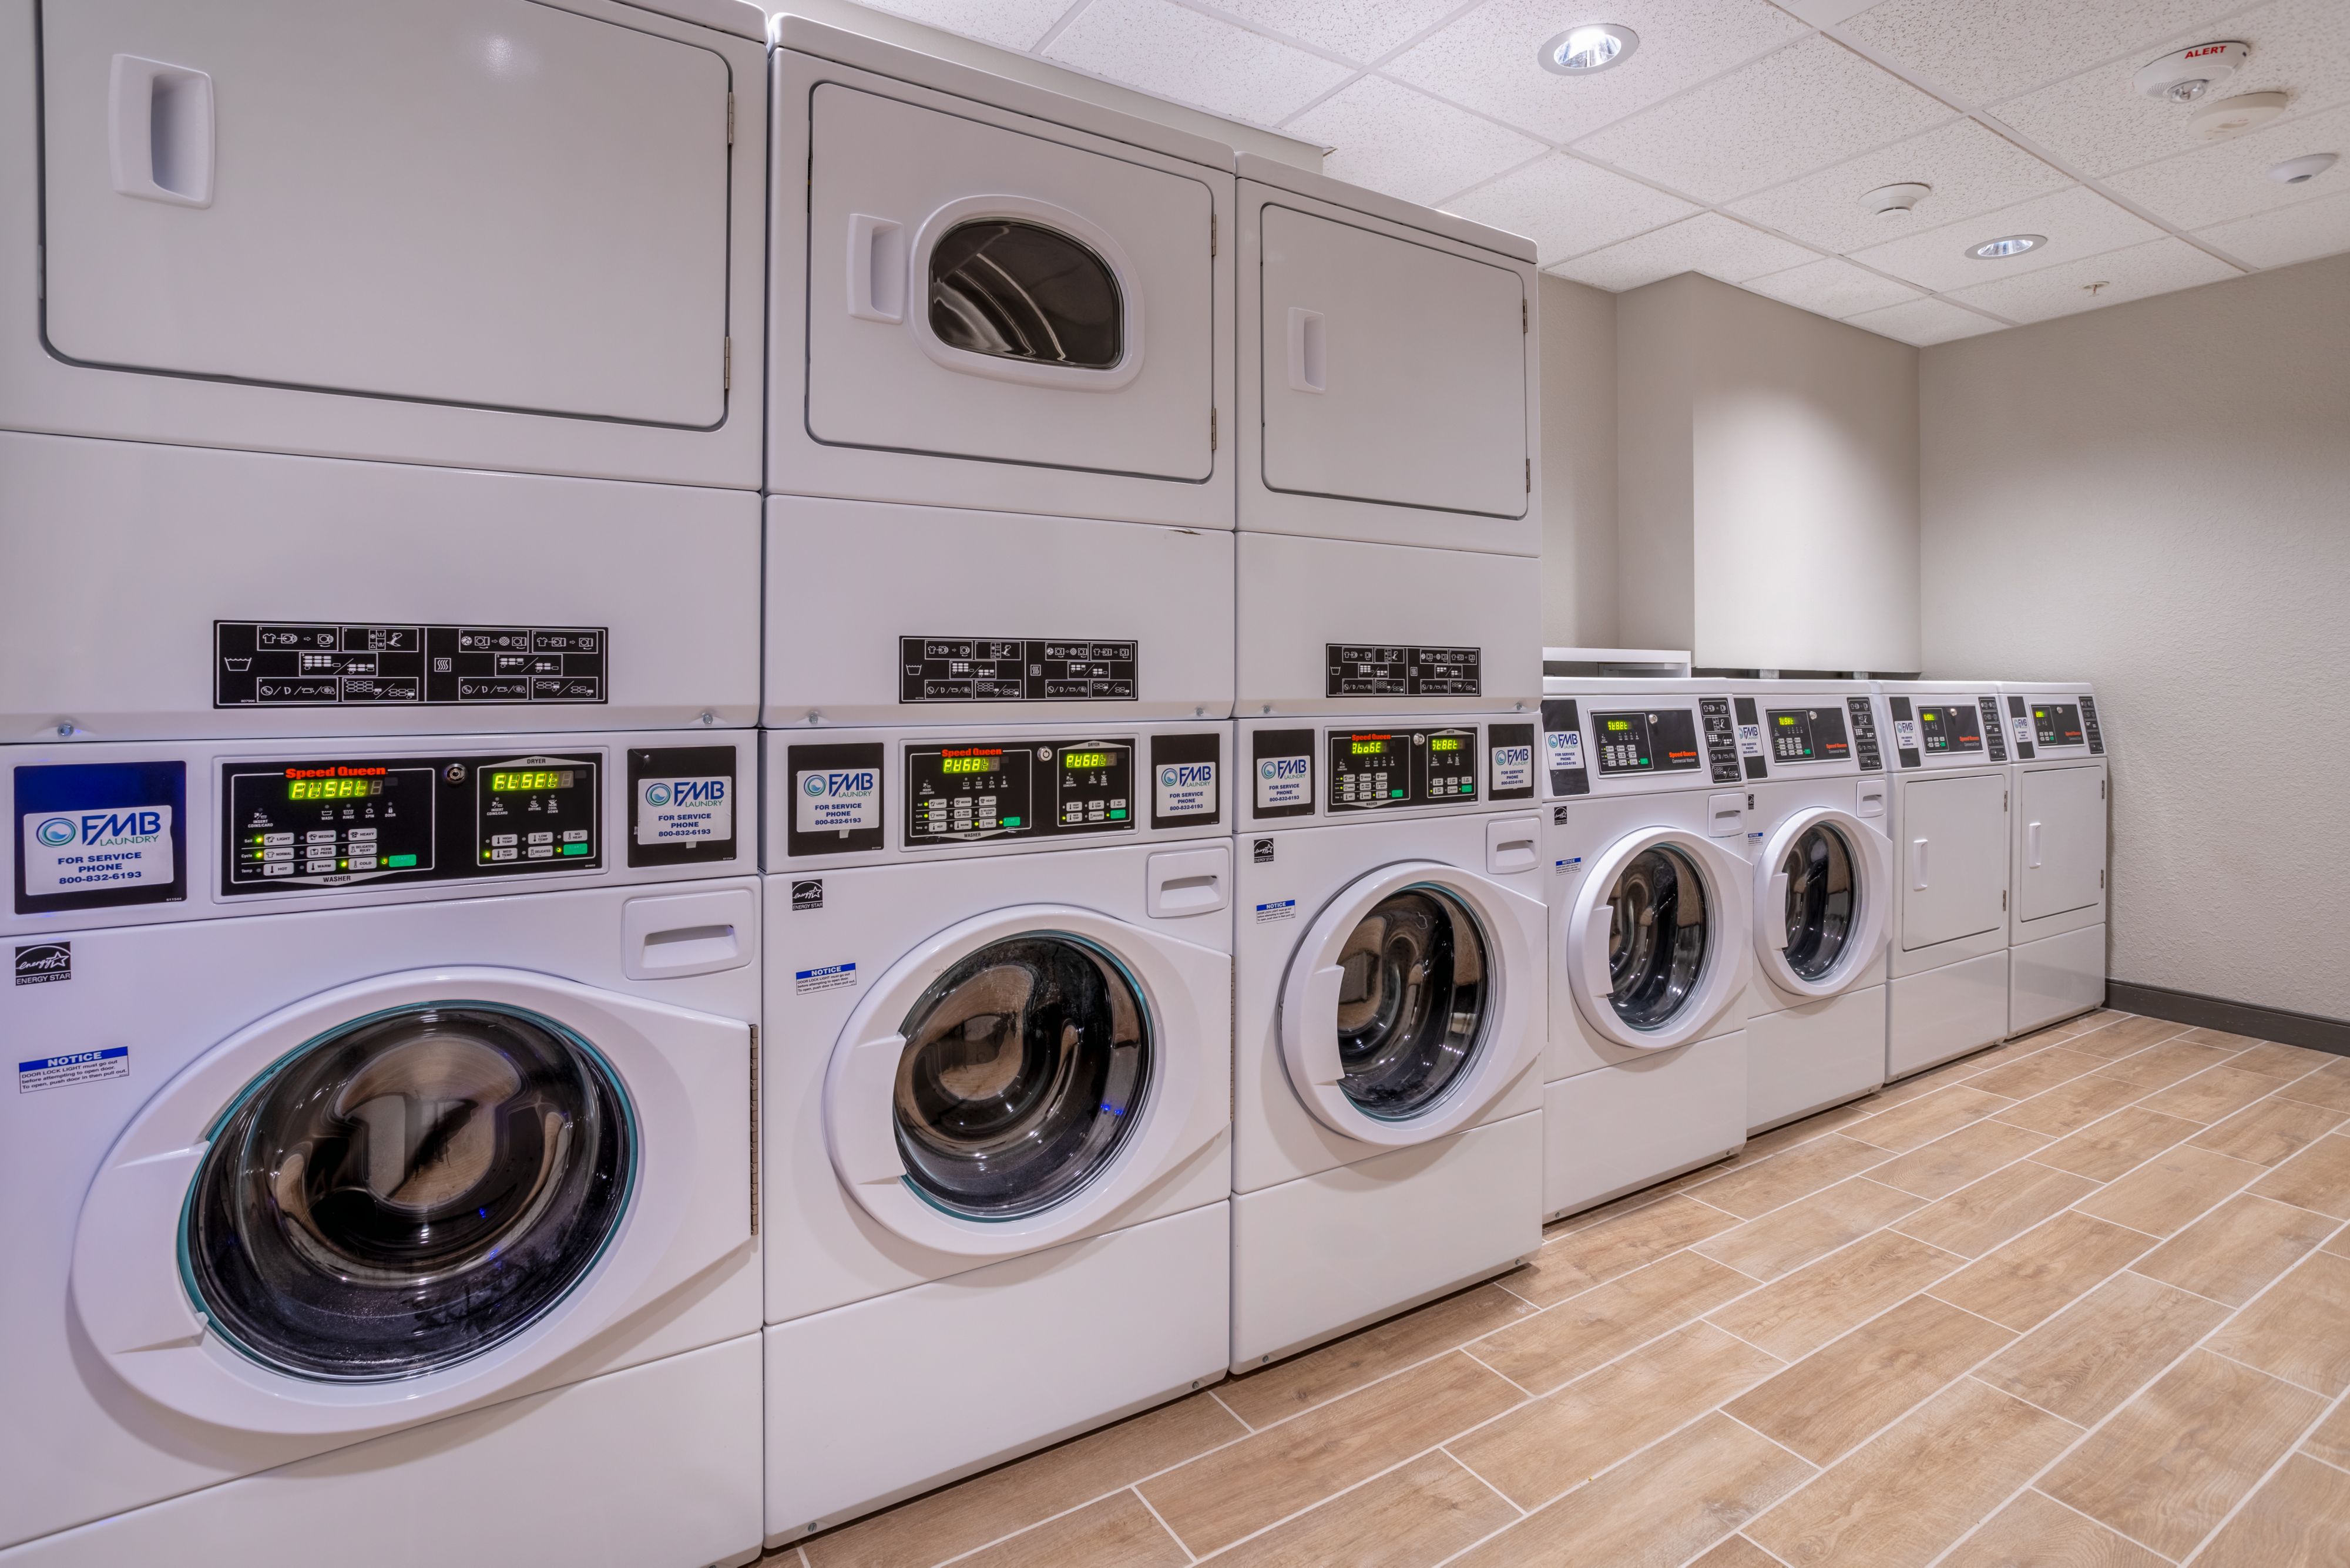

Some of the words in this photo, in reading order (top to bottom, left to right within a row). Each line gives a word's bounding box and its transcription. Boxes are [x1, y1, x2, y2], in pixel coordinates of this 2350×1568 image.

[2185, 45, 2226, 59] ALERT
[1902, 723, 1913, 733] FMB
[2019, 719, 2027, 728] FMB
[1743, 727, 1758, 739] FMB
[1558, 734, 1578, 748] FMB
[942, 748, 971, 758] Speed
[1508, 748, 1528, 765] FMB
[286, 767, 335, 780] Speed
[338, 766, 386, 776] Queen
[1278, 759, 1306, 778] FMB
[1180, 766, 1211, 786] FMB
[829, 773, 873, 796] FMB
[674, 781, 724, 806] FMB
[82, 812, 161, 845] FMB
[100, 835, 159, 846] LAUNDRY
[88, 852, 142, 862] SERVICE
[79, 864, 122, 873] PHONE
[59, 871, 142, 885] 800-832-6193
[811, 966, 841, 976] NOTICE
[16, 976, 48, 985] ENERGY
[48, 1052, 102, 1067] NOTICE
[43, 1072, 75, 1080] attempting
